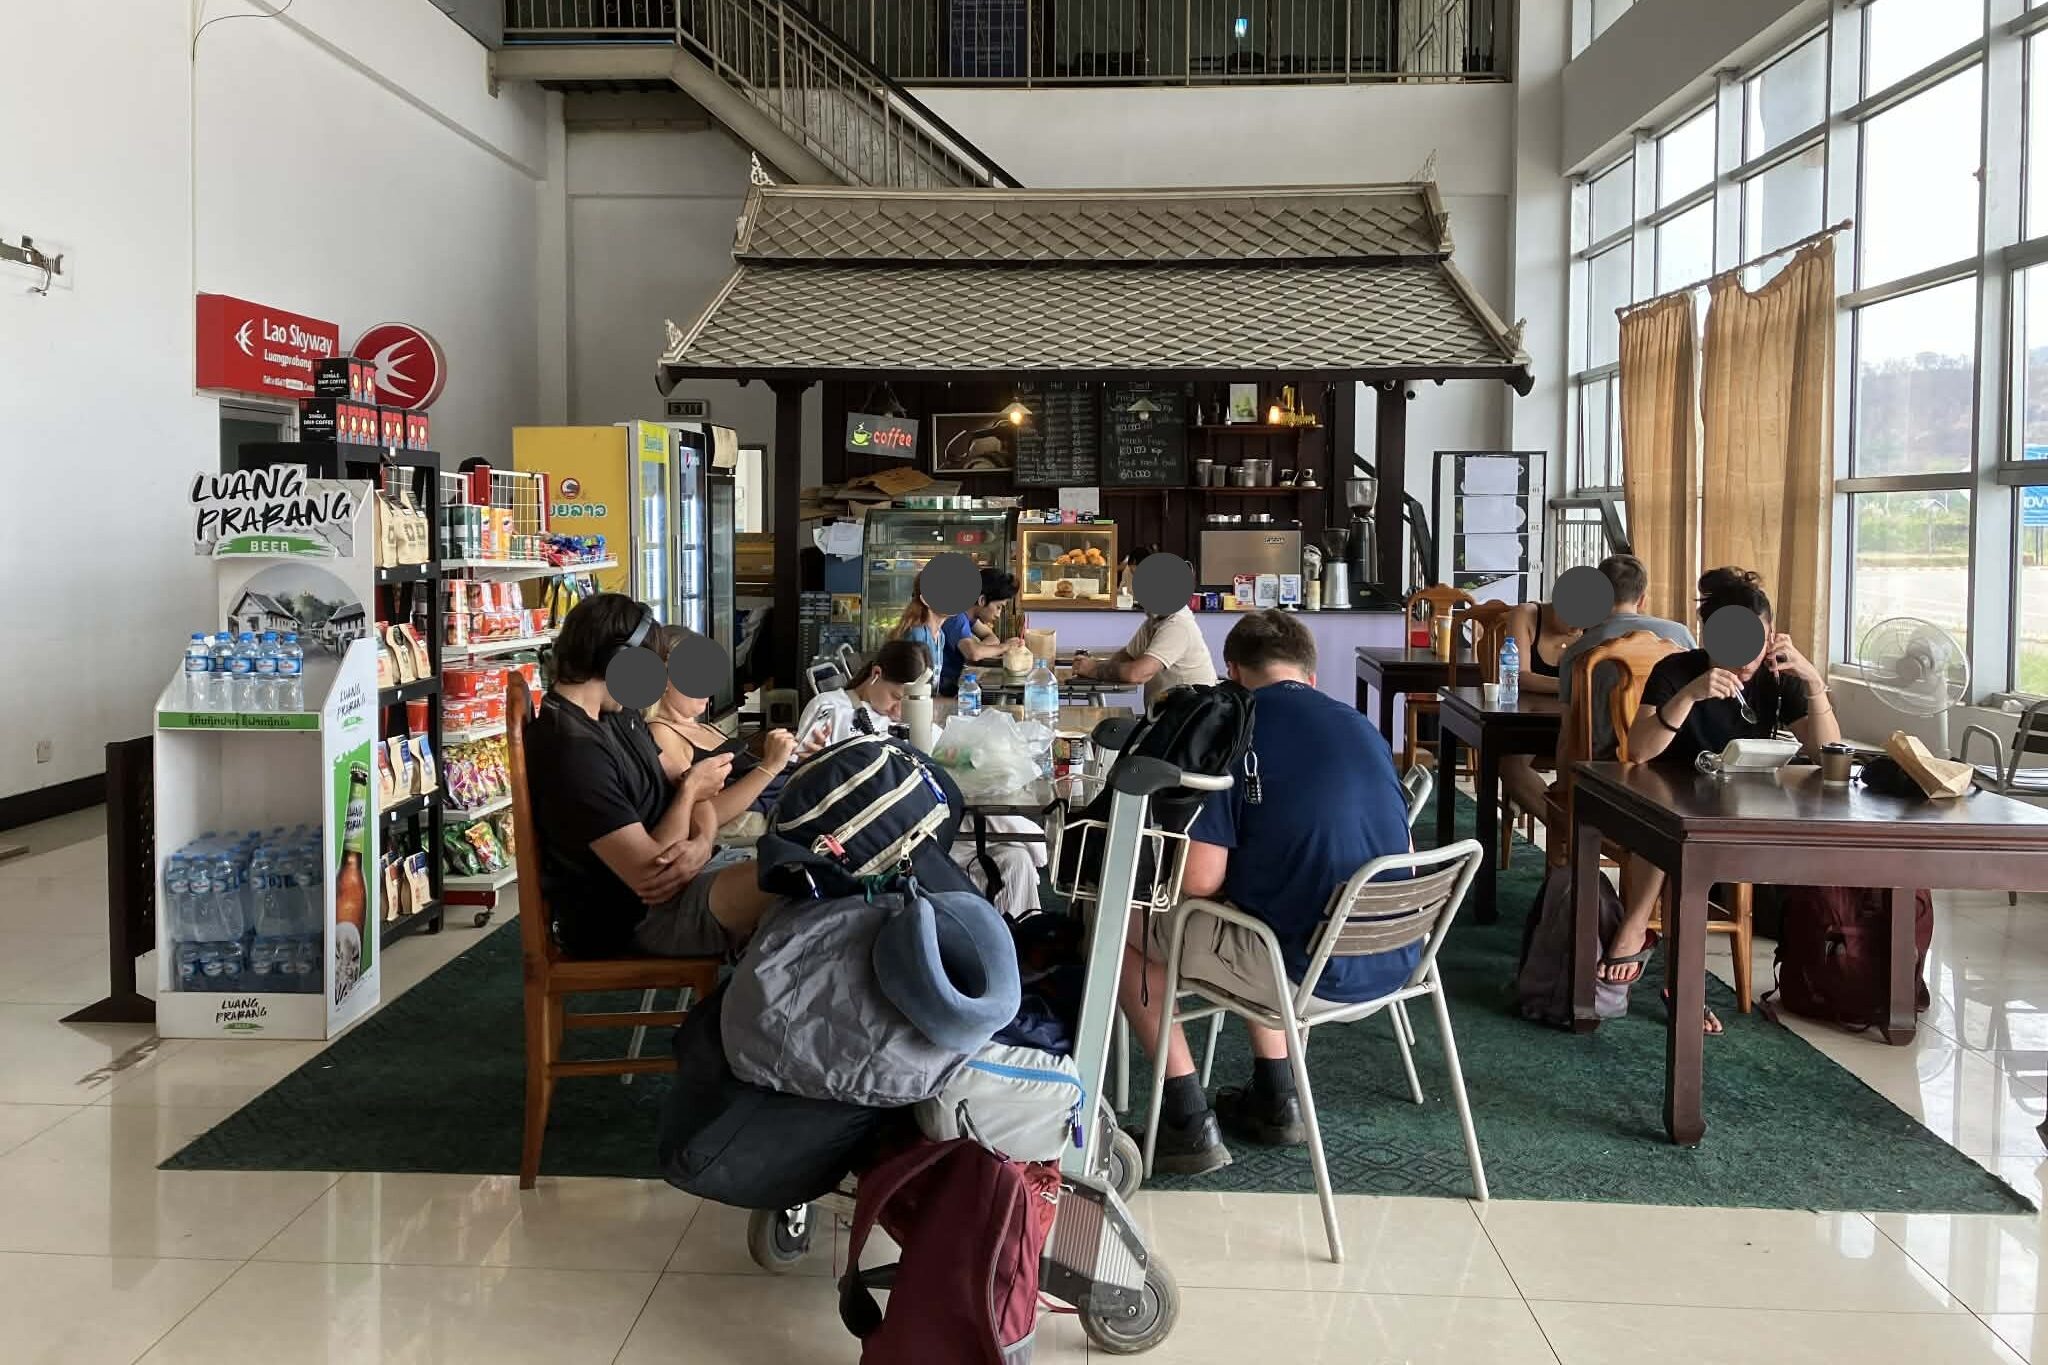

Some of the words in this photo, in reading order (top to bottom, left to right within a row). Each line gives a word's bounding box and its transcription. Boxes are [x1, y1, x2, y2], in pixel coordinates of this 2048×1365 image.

[262, 318, 287, 343] Lao
[288, 324, 333, 359] Skyway
[671, 403, 700, 415] EXIT
[873, 427, 912, 449] coffee
[192, 468, 303, 503] LUANG
[196, 491, 350, 541] PRABANG
[250, 540, 289, 552] BEER
[221, 997, 259, 1009] LUANG
[215, 1006, 267, 1024] PRABANG
